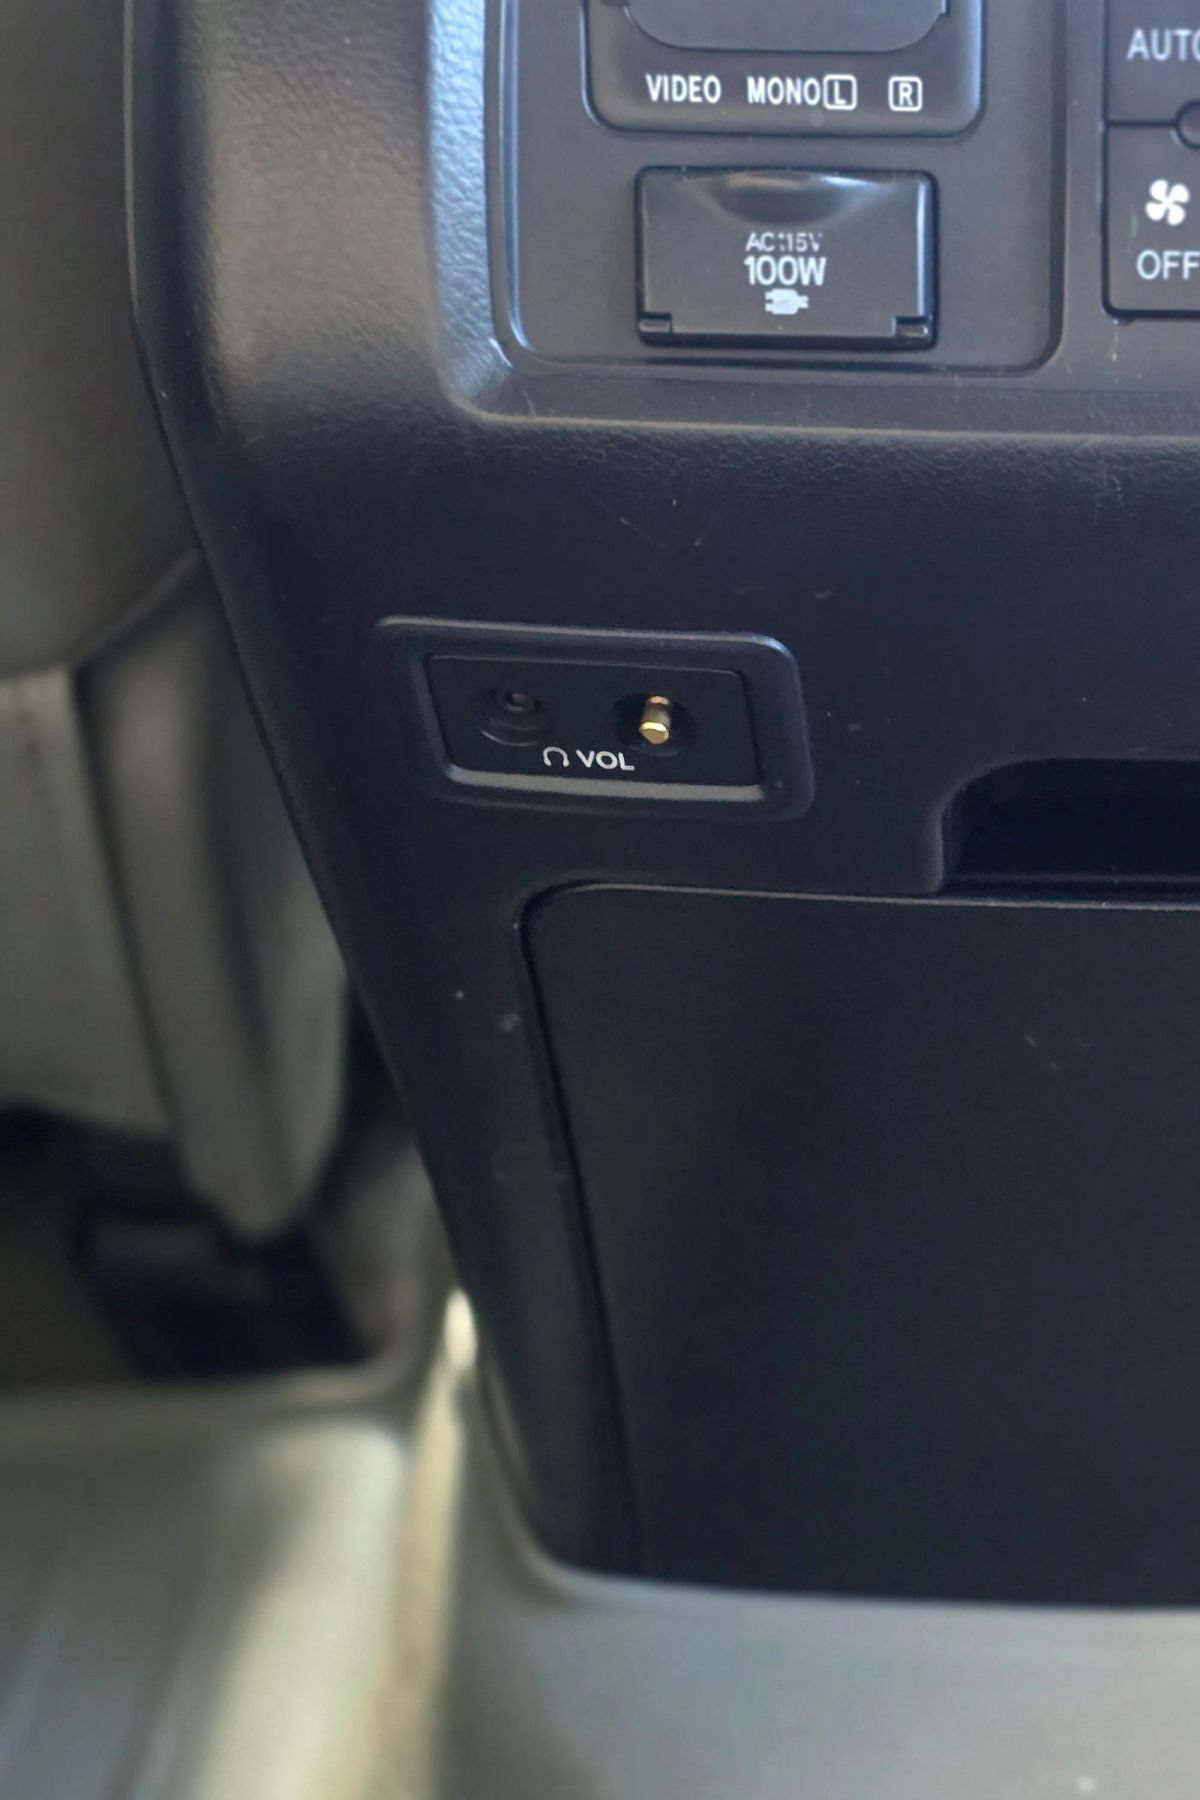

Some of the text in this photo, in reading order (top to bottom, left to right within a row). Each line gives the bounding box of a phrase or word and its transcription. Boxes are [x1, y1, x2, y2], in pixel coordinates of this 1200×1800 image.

[645, 74, 722, 104] VIDEO
[743, 255, 827, 286] 100W
[575, 749, 636, 772] VOL
